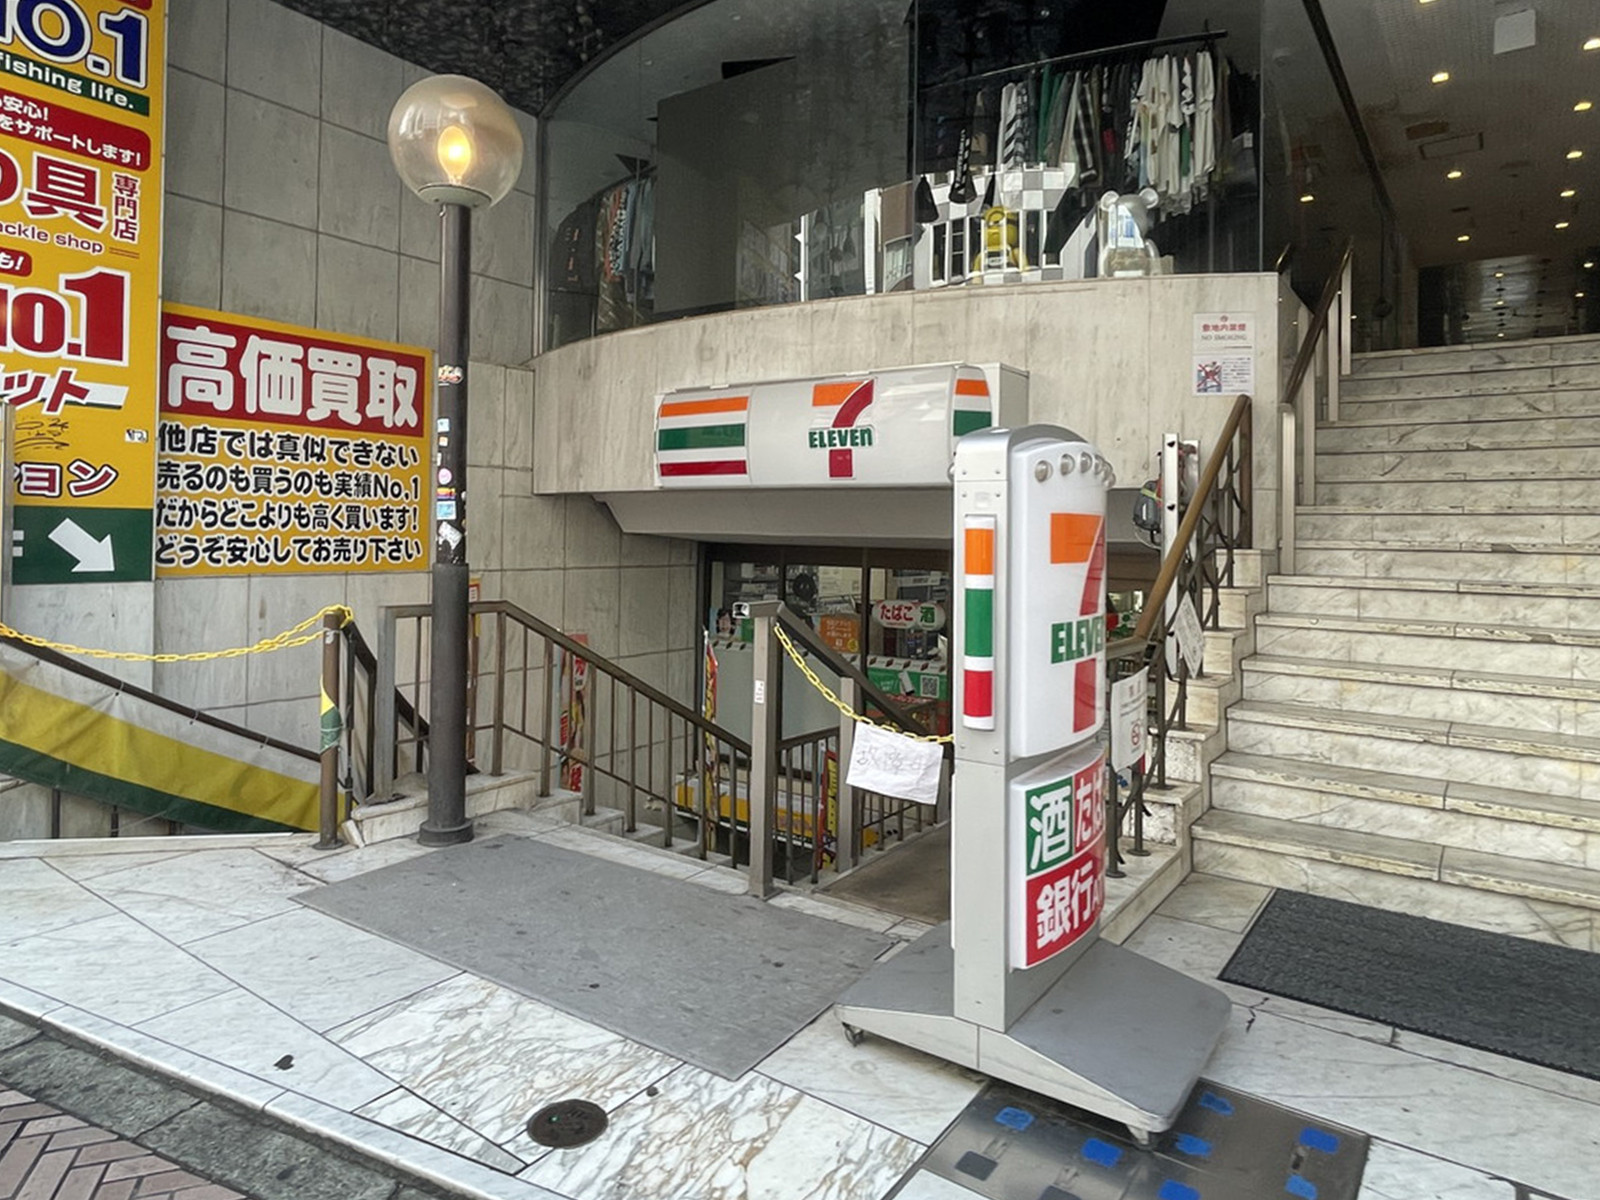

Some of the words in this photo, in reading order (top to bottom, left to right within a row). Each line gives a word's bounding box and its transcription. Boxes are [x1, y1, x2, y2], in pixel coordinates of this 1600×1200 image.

[0, 95, 48, 121] 安心!
[91, 82, 134, 109] life.
[111, 172, 140, 244] 専門店
[55, 234, 104, 254] shop
[166, 325, 420, 428] 高価買取
[158, 421, 420, 469] 他店では真似できない
[156, 497, 420, 532] だからどこよりも高く買います!
[155, 534, 423, 566] どうぞ安心してお売り下さい
[881, 604, 914, 621] たばこ
[1030, 785, 1073, 871] 酒
